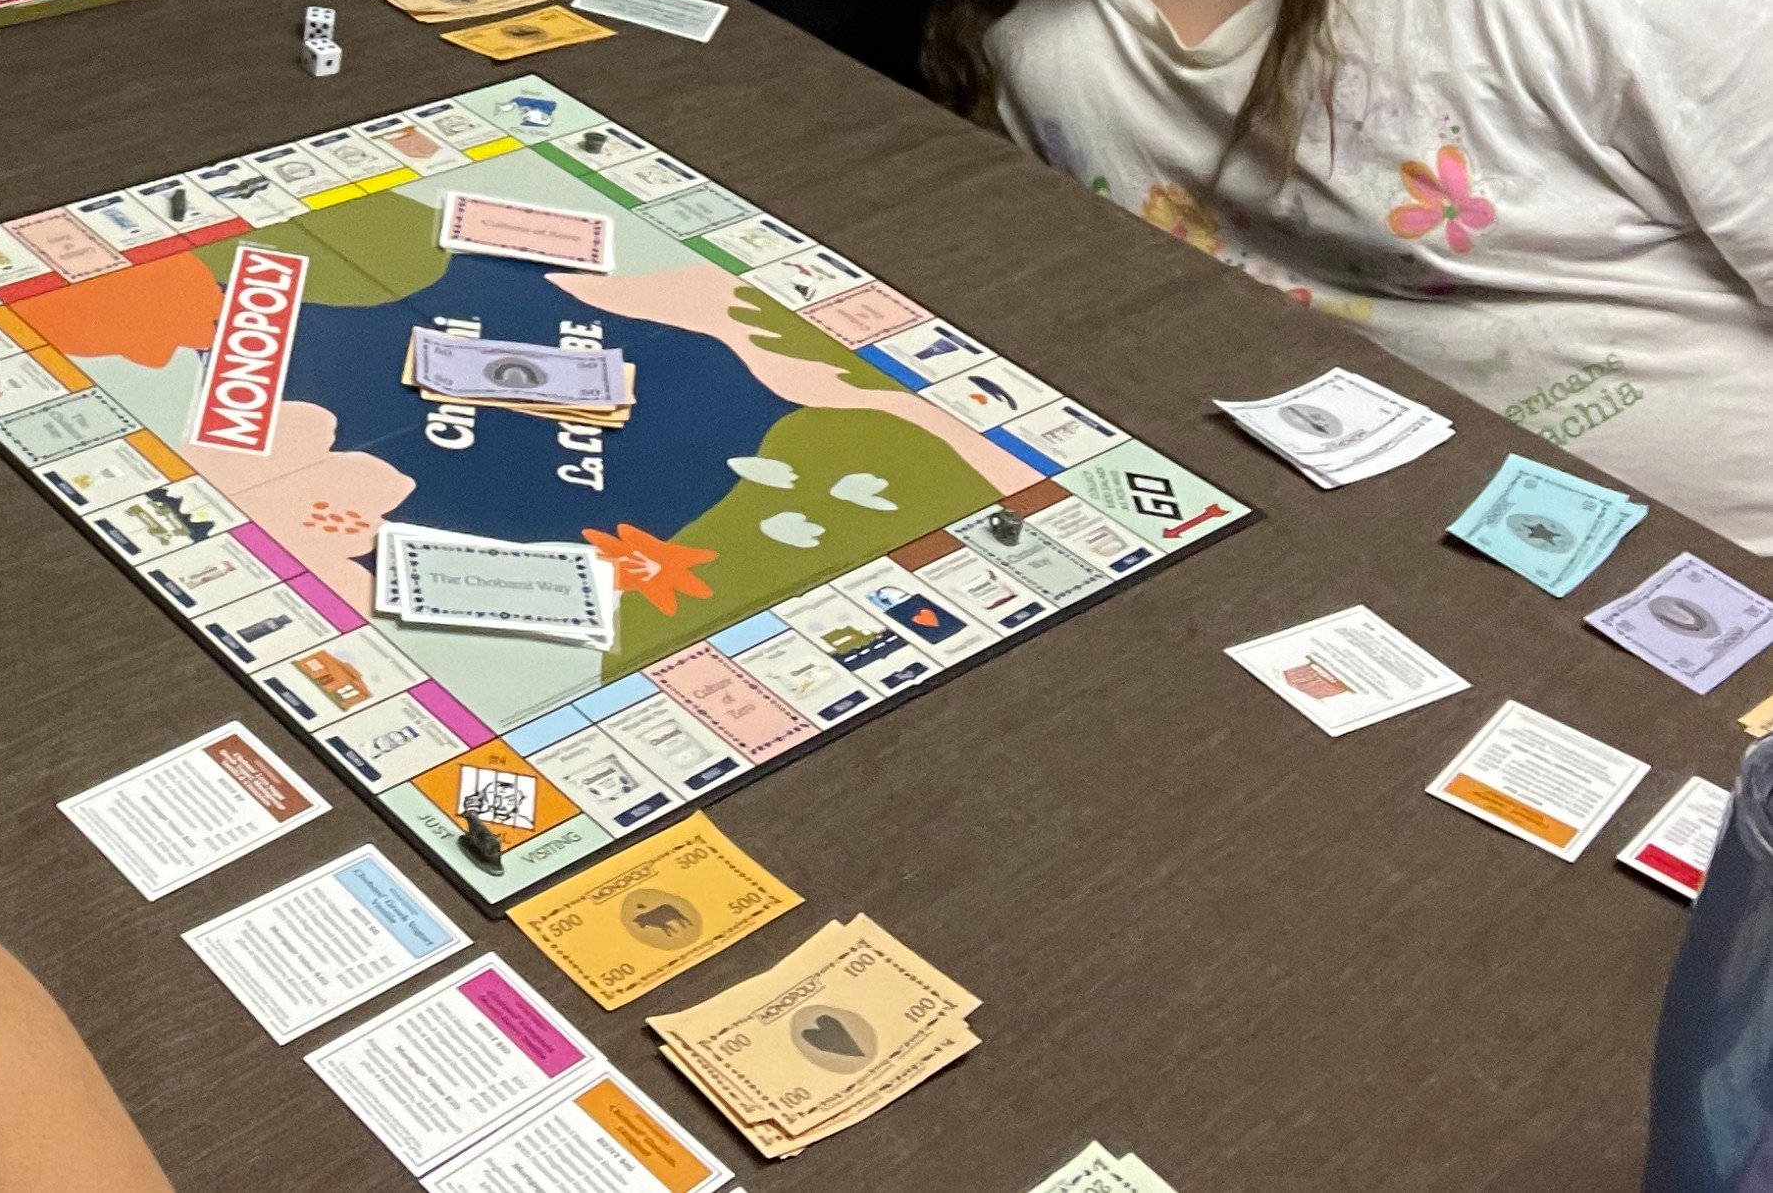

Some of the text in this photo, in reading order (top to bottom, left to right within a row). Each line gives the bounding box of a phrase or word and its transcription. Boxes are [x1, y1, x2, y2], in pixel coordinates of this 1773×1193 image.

[205, 252, 294, 446] MONOPOLY
[1124, 471, 1184, 521] GO
[416, 814, 456, 840] JUST
[521, 830, 583, 865] VISITING
[673, 846, 710, 870] 500
[726, 891, 763, 916] 500
[547, 913, 584, 939] 500
[599, 962, 636, 988] 500
[843, 952, 876, 978] 100
[904, 996, 937, 1024] 100
[719, 1033, 753, 1057] 100
[778, 1086, 812, 1110] 100
